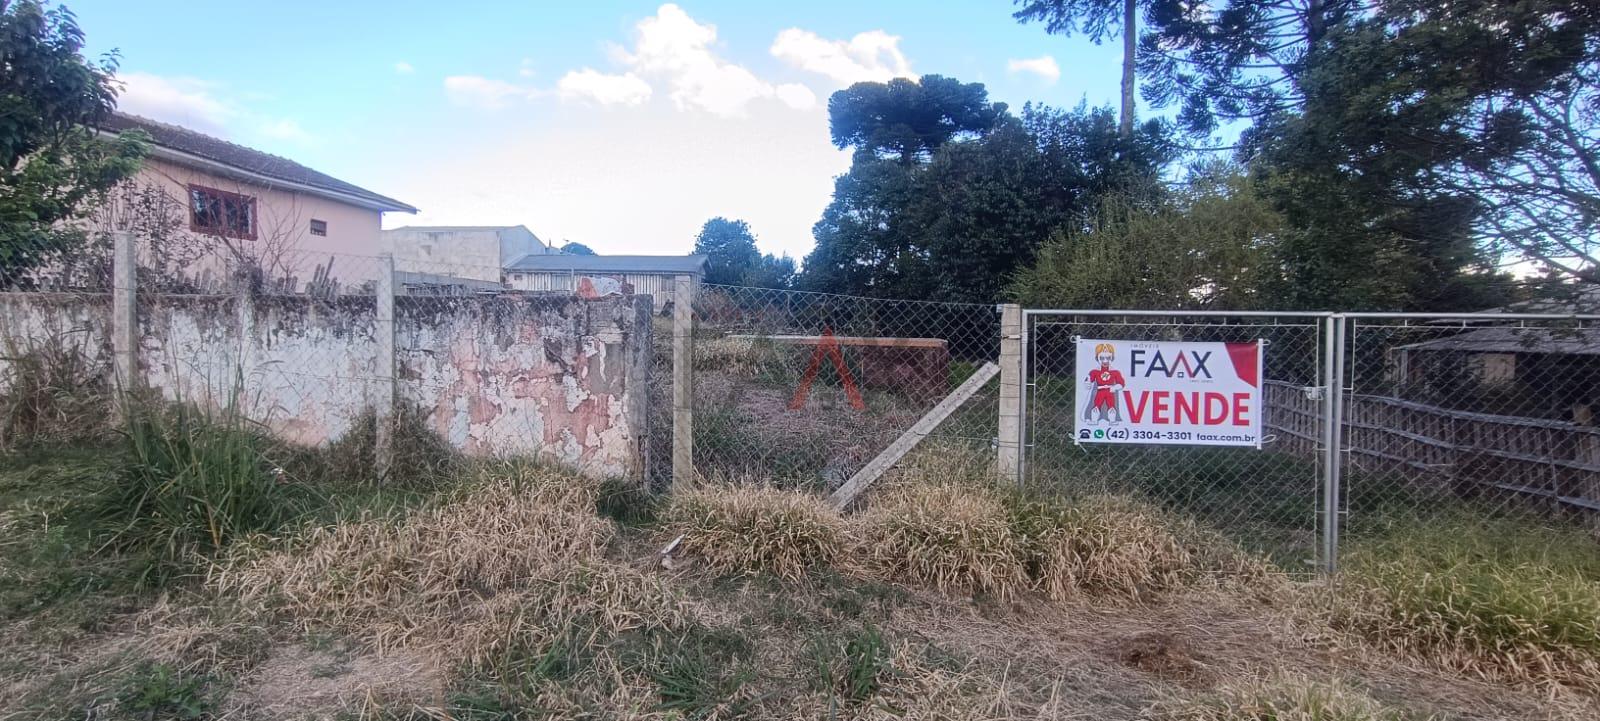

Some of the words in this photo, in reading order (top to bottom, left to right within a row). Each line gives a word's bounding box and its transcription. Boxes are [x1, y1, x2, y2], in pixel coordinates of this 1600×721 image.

[1130, 350, 1213, 379] FAAX
[1123, 390, 1250, 426] VENDE
[1106, 427, 1129, 441] (42)
[1133, 430, 1192, 441] 3304-3301
[1197, 432, 1256, 442] faax.com.br
